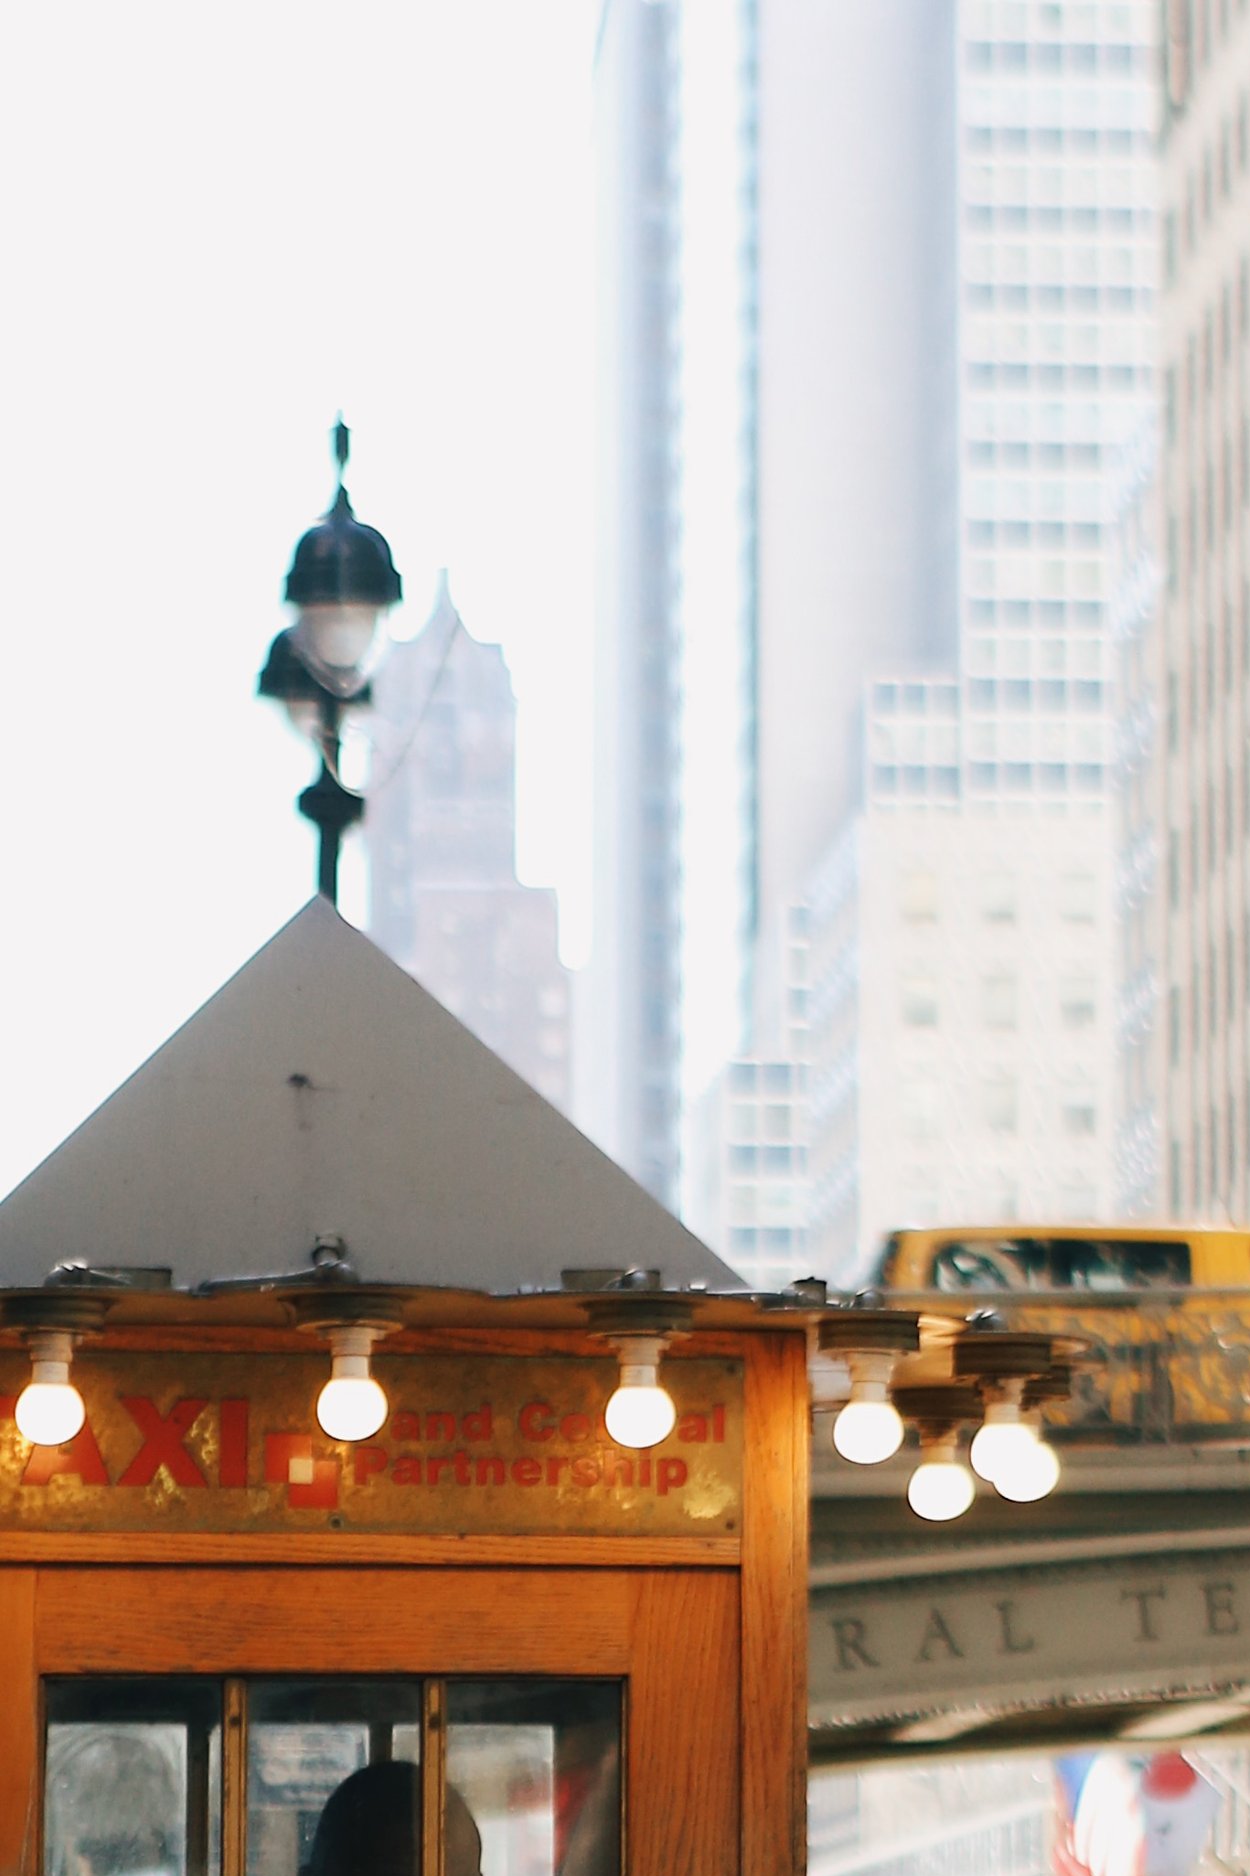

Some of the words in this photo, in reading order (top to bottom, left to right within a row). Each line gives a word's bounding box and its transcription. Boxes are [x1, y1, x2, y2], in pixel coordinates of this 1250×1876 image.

[0, 1395, 248, 1488] AXI
[386, 1402, 493, 1443] and
[518, 1401, 726, 1444] Ceal
[354, 1446, 689, 1496] Partnership
